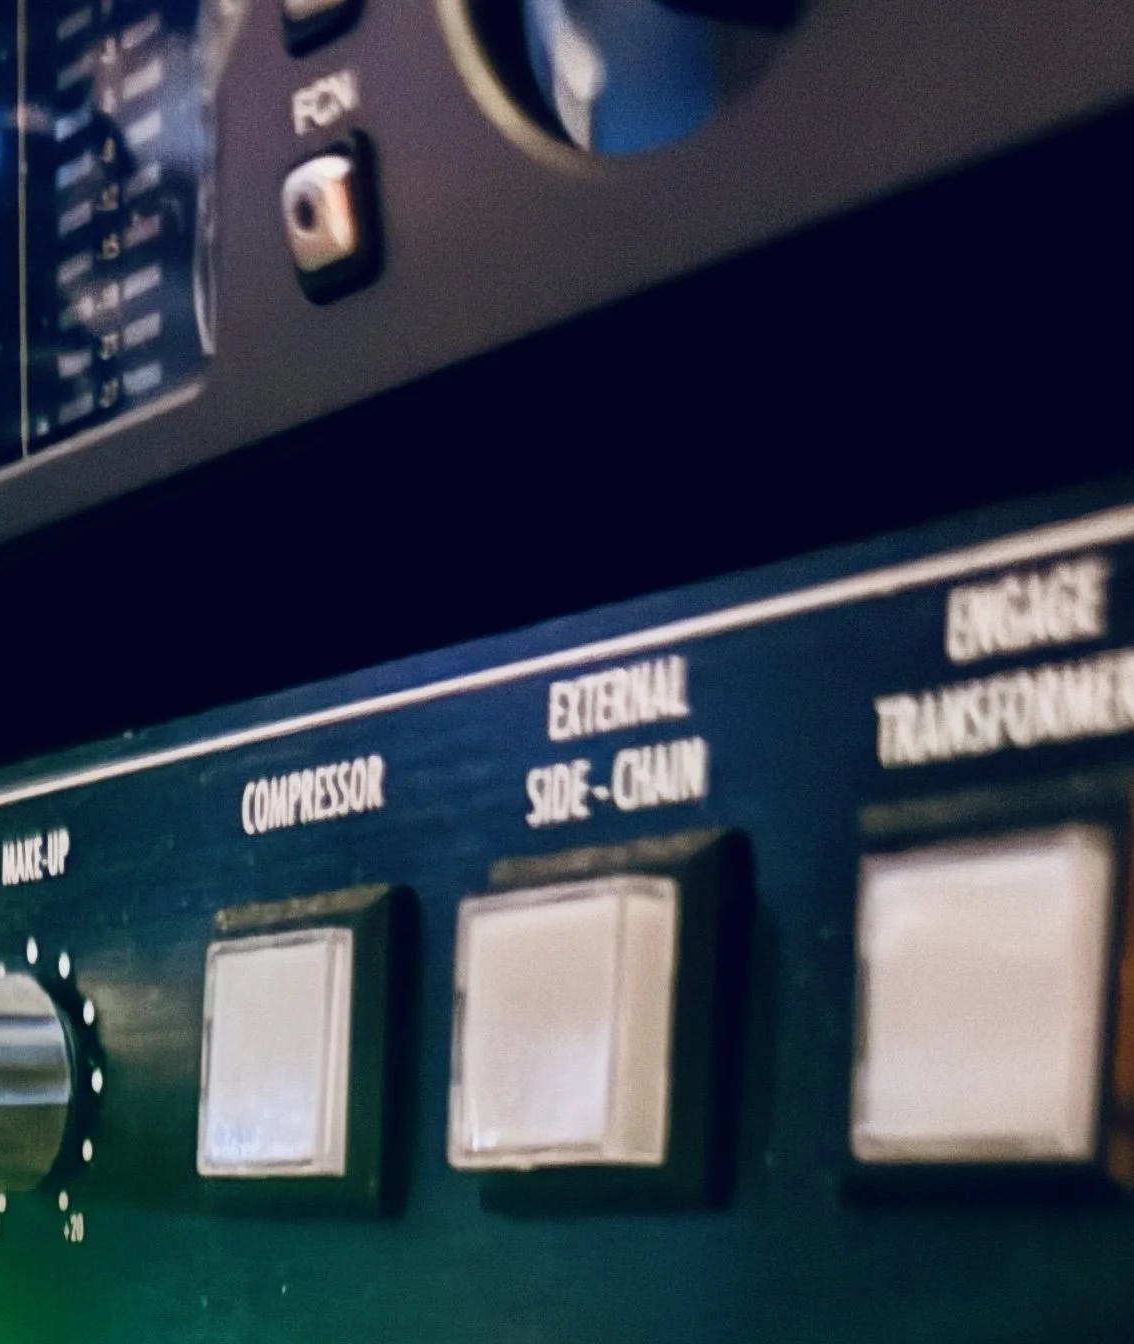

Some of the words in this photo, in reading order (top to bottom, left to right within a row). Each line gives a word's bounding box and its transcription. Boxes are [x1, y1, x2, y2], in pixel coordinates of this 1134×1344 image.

[944, 558, 1110, 666] ENGAGE
[547, 654, 691, 743] EXTERNAL
[241, 754, 386, 836] COMPRESSOR
[1, 829, 70, 886] MAKE-UP
